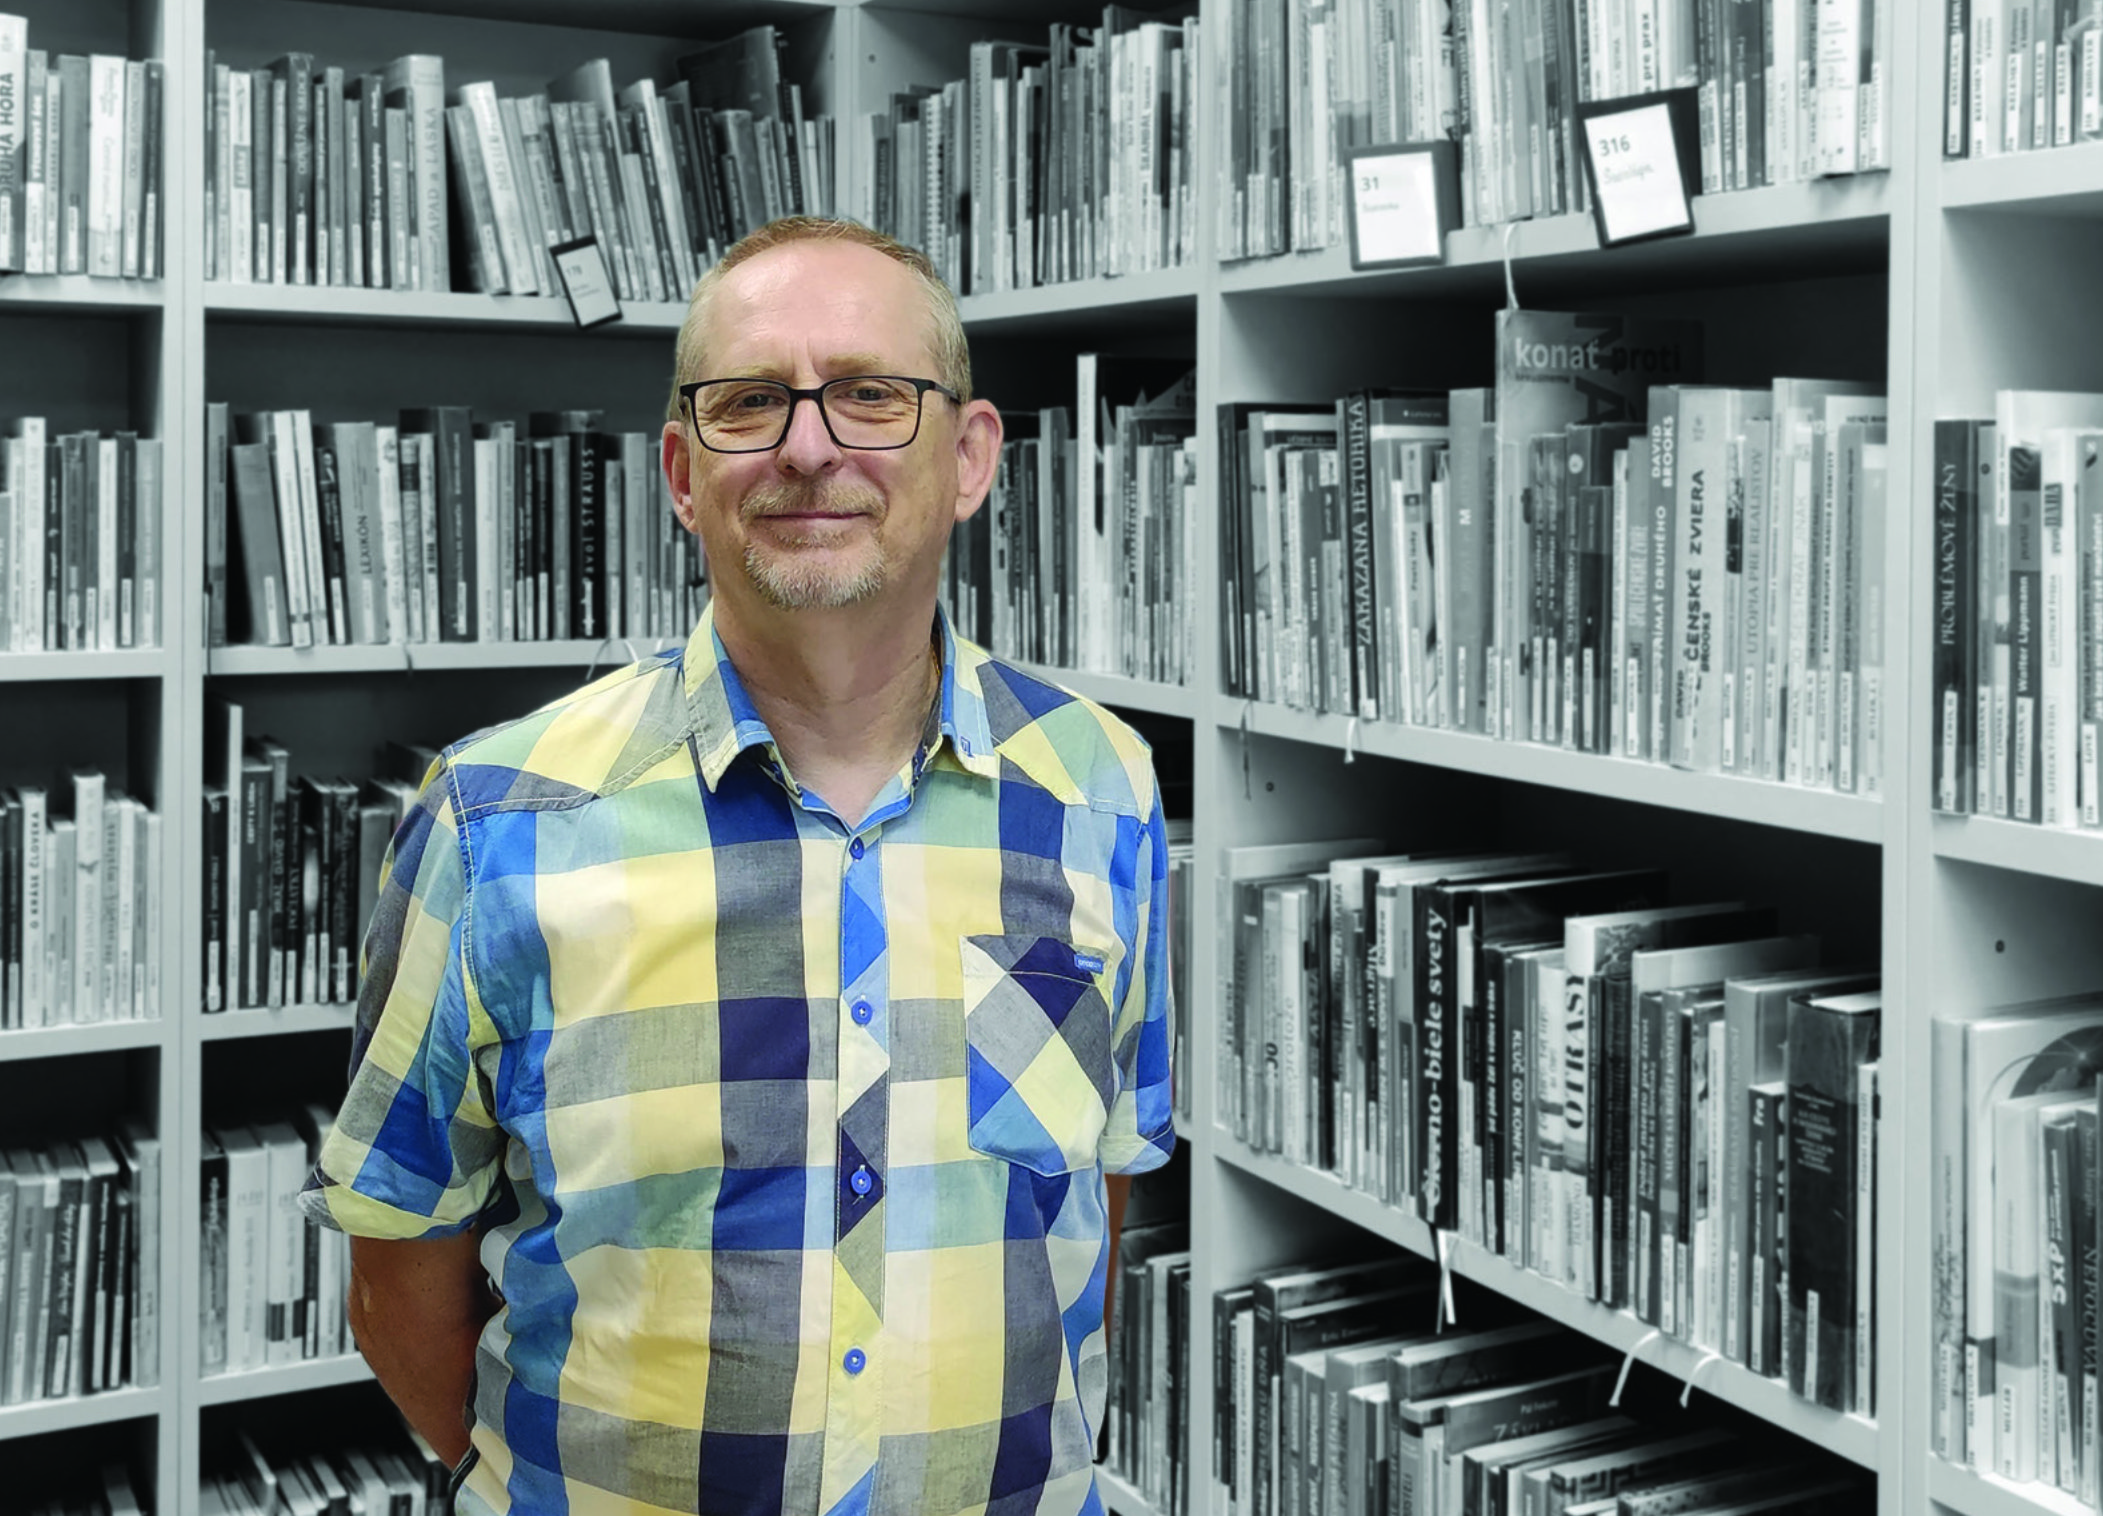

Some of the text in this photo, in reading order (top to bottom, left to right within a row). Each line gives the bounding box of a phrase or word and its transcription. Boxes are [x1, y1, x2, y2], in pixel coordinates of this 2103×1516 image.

[1640, 13, 1656, 48] prax
[0, 73, 13, 126] HORA
[1598, 134, 1631, 158] 316
[1361, 176, 1380, 192] 31
[1515, 337, 1600, 370] konať
[1651, 424, 1662, 478] DAVID
[1662, 415, 1674, 488] BROOKS
[581, 448, 594, 526] STRAUSS
[1690, 469, 1704, 555] ZVIERA
[356, 515, 372, 574] LEXIKÓN
[1653, 505, 1666, 590] DRUHÉHO
[1747, 548, 1761, 581] PRE
[1938, 460, 1957, 645] PROBLÉMOVÉ ŽENY
[1700, 612, 1711, 673] BROOKS
[2016, 576, 2031, 692] Walter Lippmann
[1675, 669, 1685, 719] DAVID
[26, 811, 39, 868] ČLOVEKA
[27, 875, 39, 915] KRÁSE
[1425, 907, 1447, 997] svety
[1564, 974, 1585, 1130] OTRASY
[1511, 1077, 1523, 1100] OD
